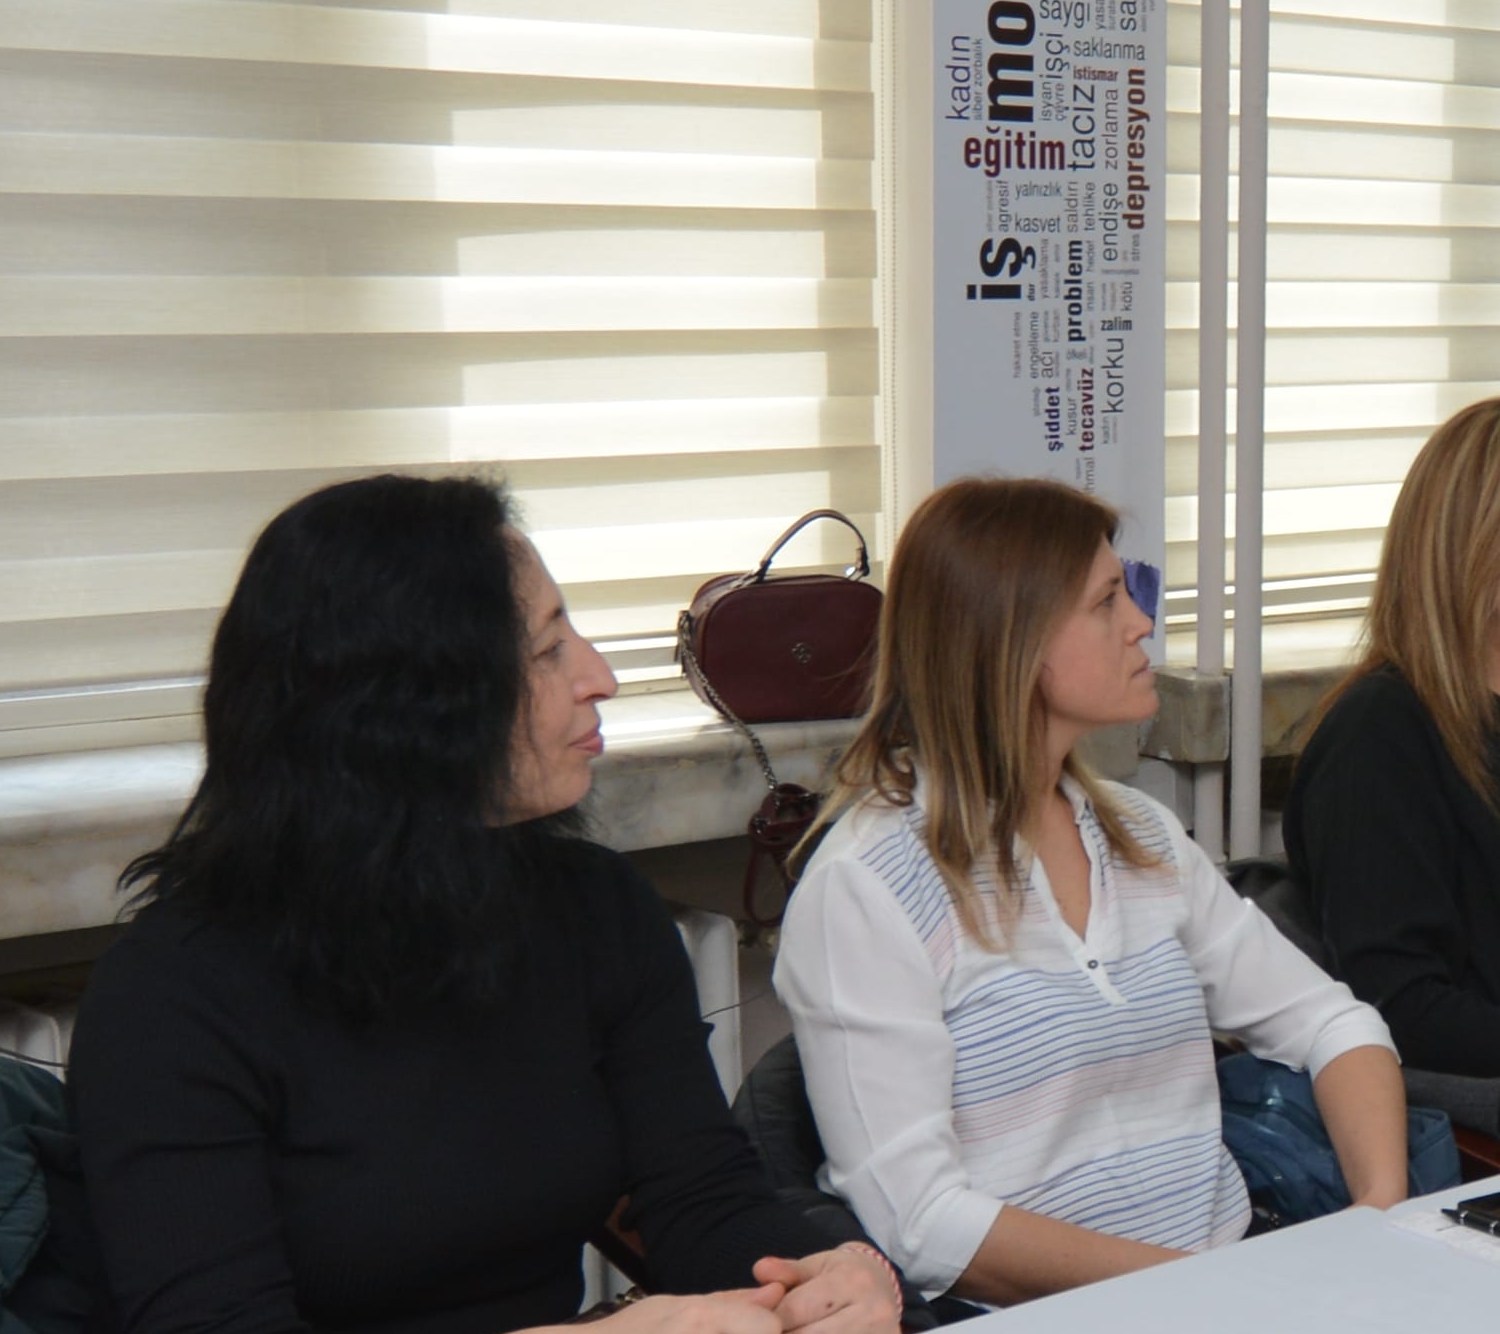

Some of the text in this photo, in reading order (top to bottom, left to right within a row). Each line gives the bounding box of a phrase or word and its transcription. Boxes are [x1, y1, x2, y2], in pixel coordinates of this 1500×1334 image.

[1040, 32, 1070, 79] işçi
[1073, 39, 1145, 61] saklanma
[1073, 65, 1118, 82] istismar
[945, 35, 970, 121] kadın
[1040, 81, 1054, 121] isyan
[964, 126, 1066, 178] eğitim
[1064, 83, 1095, 172] taciz
[1103, 88, 1119, 171] zorlama
[1122, 68, 1151, 230] depresyon
[997, 179, 1012, 233] agresif
[1014, 179, 1063, 201] yalnızlık
[1064, 181, 1079, 233] saldırı
[1083, 182, 1096, 232] tehlike
[1013, 213, 1061, 233] kasvet
[1099, 182, 1124, 262] endişe
[966, 236, 1036, 301] iş
[1026, 283, 1035, 301] dur
[1063, 239, 1086, 343] problem
[1121, 281, 1133, 312] kötü
[1101, 317, 1132, 331] zalim
[1100, 337, 1125, 414] korku
[1045, 386, 1064, 452] şiddet
[1064, 397, 1077, 436] kusur
[1077, 367, 1095, 452] tecavüz
